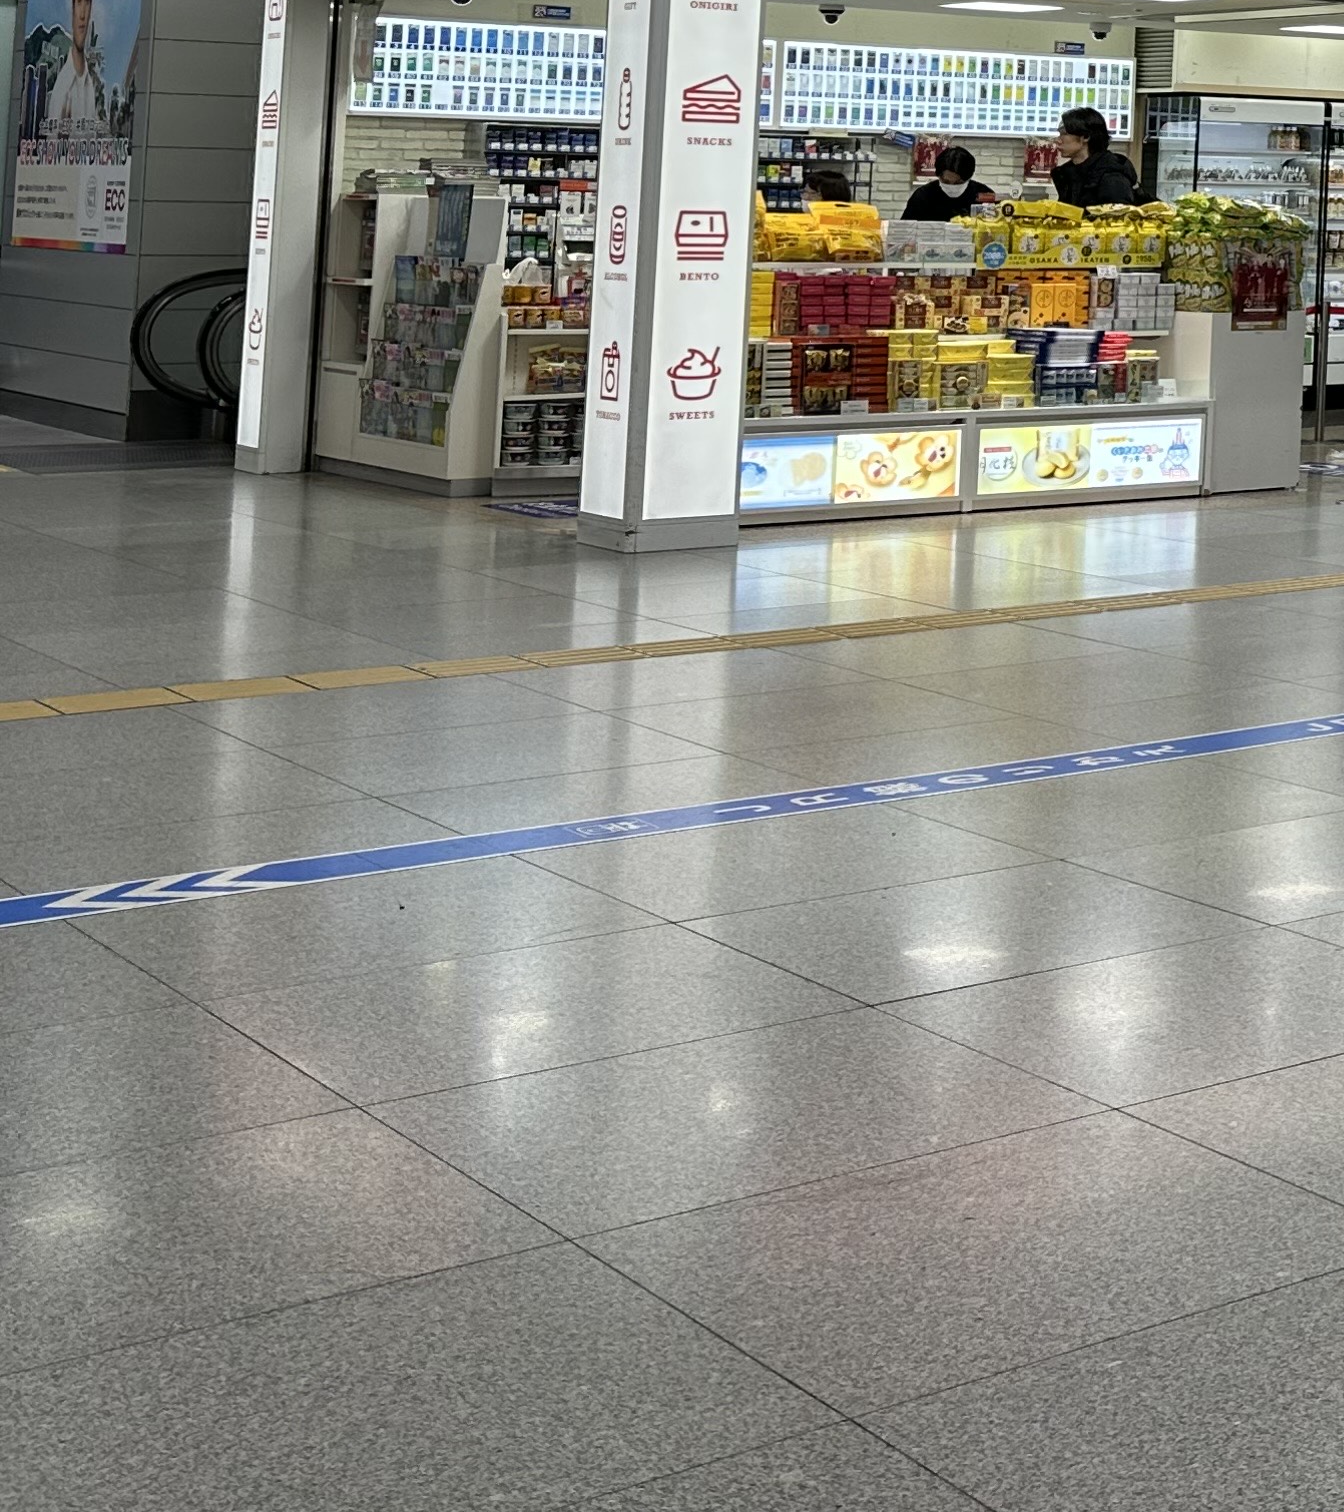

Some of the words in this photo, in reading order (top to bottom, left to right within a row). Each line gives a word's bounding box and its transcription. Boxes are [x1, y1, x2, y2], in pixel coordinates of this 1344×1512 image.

[689, 0, 738, 12] ONIGIRI
[686, 136, 733, 147] SNACKS
[104, 188, 126, 211] ECC
[679, 272, 720, 281] BENTO
[668, 410, 715, 421] SWEETS
